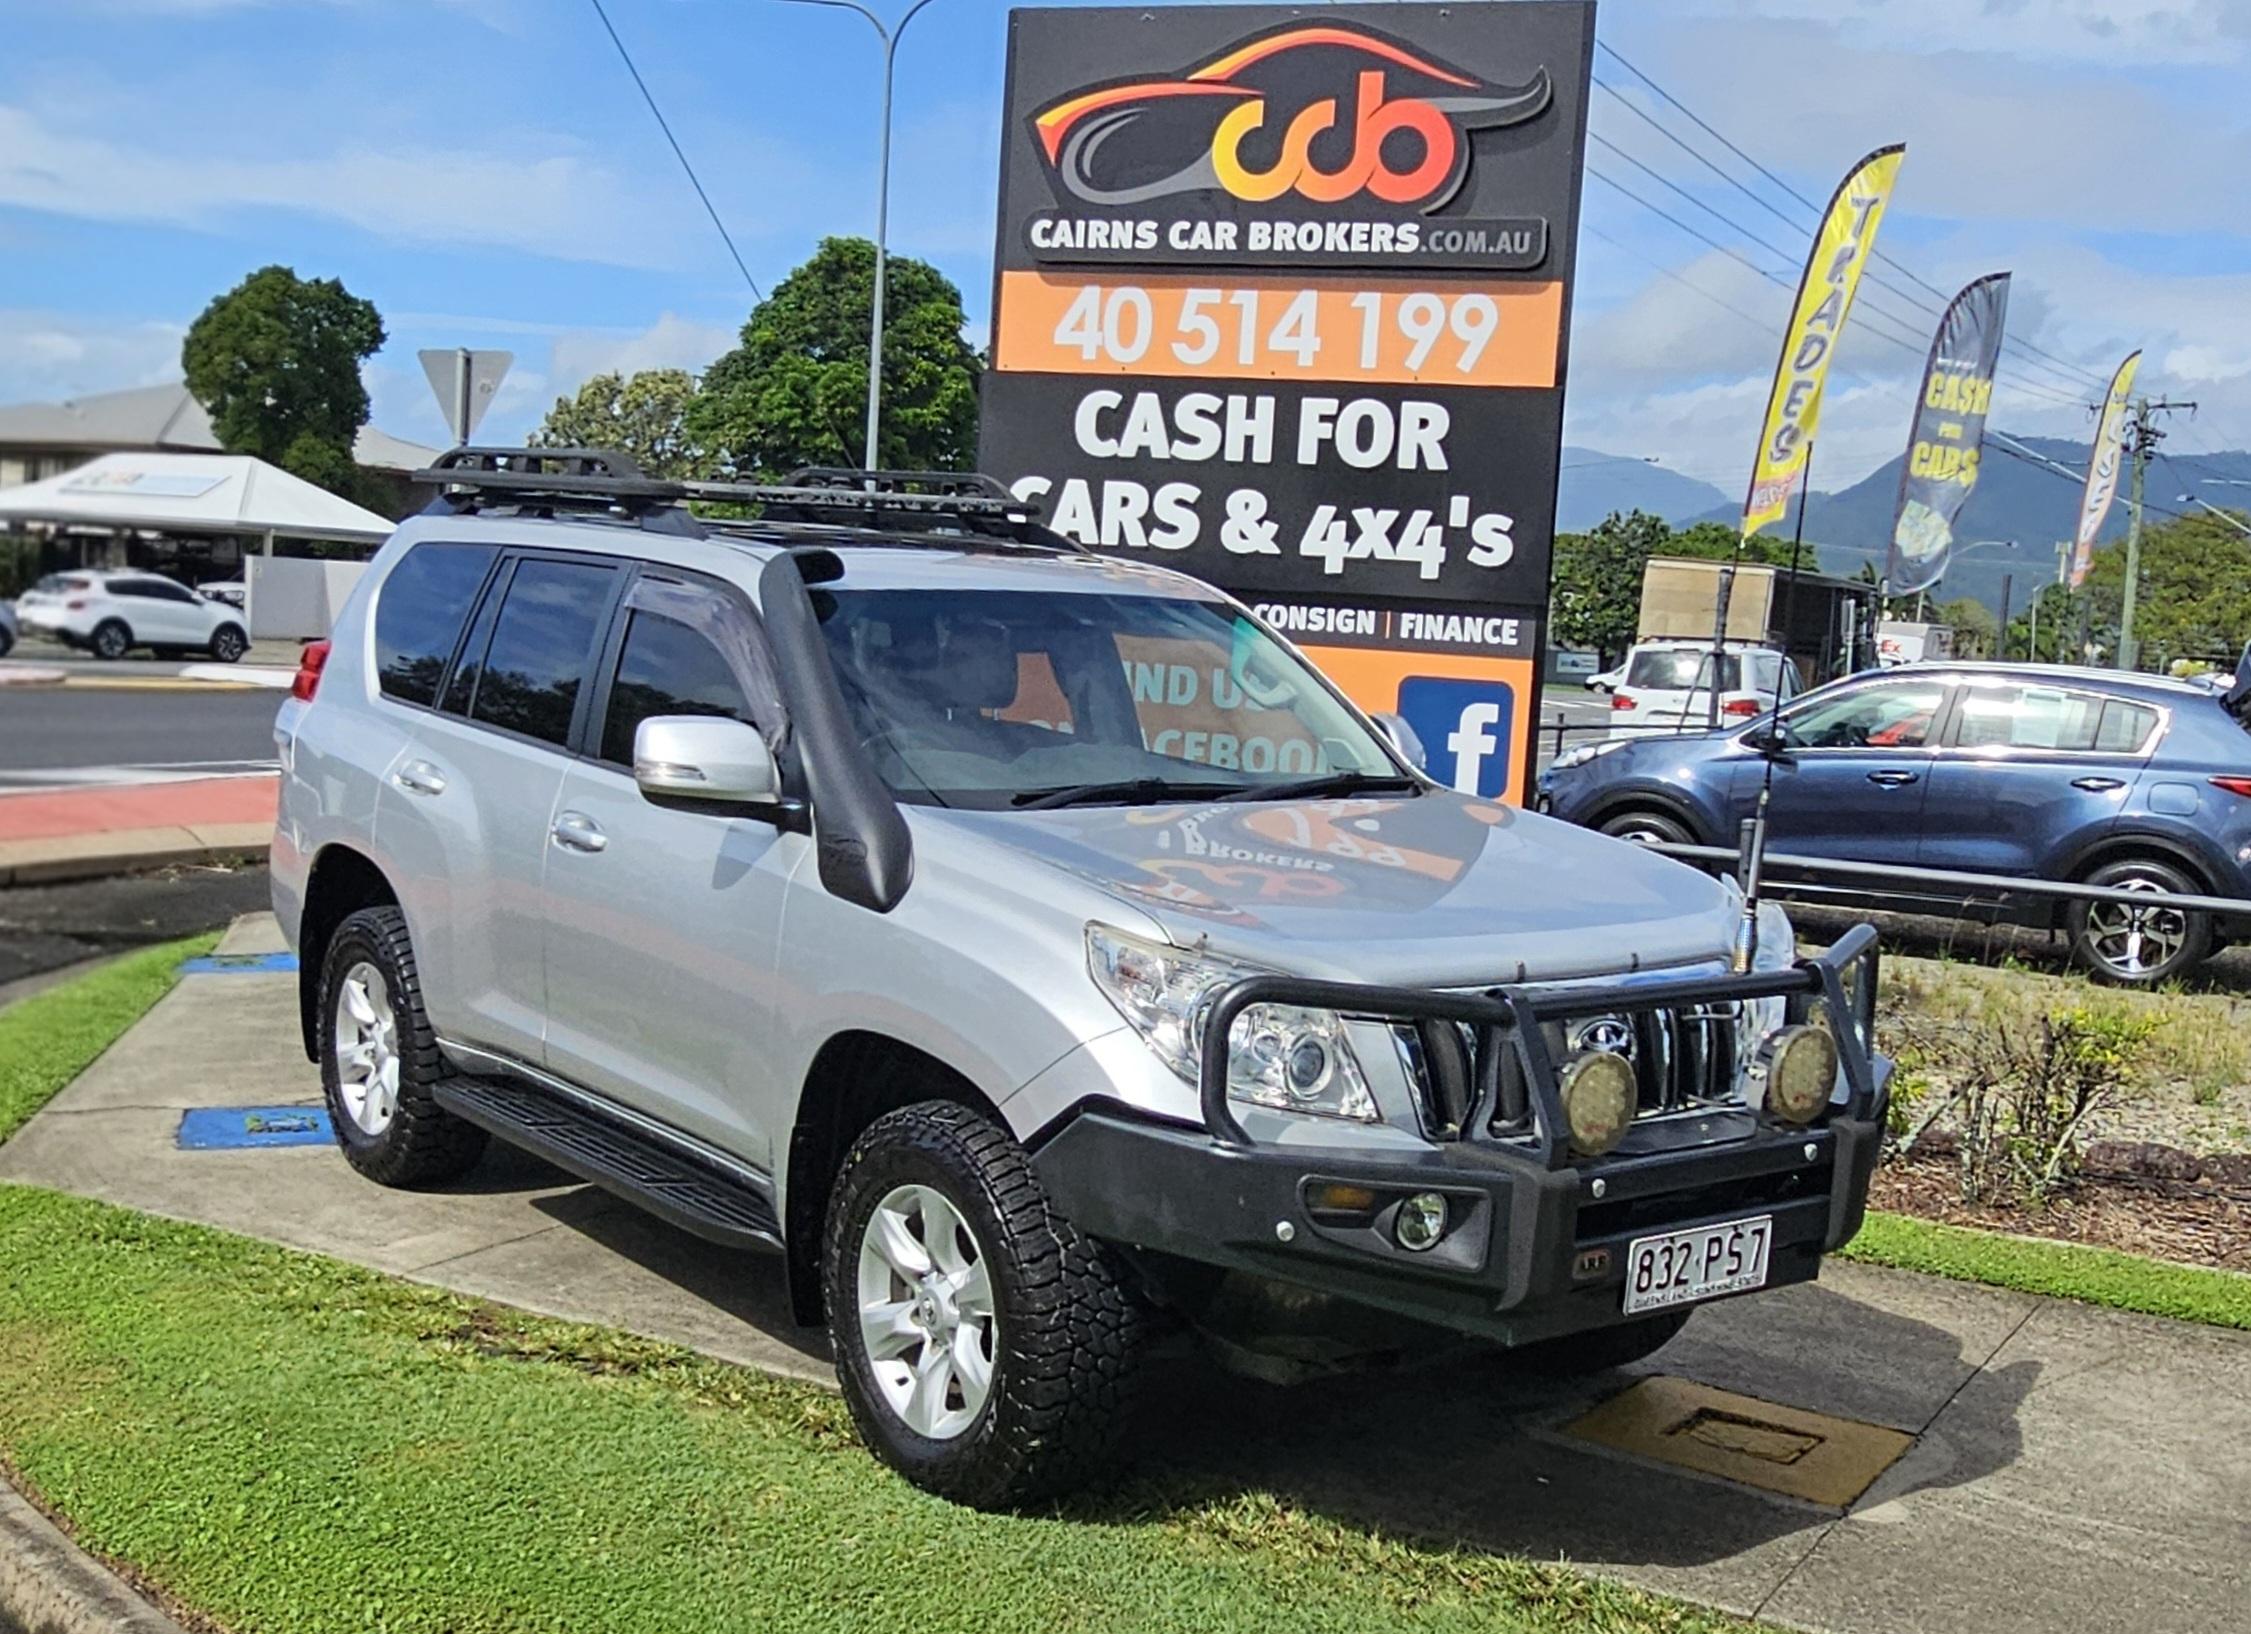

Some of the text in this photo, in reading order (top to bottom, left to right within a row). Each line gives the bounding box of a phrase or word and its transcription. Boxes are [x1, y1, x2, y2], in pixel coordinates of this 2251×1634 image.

[1031, 218, 1532, 255] CAIRNS CAR BROKERS.COM.AU
[1053, 285, 1499, 373] 40 514 199
[1768, 196, 1879, 464] TRADES
[1925, 372, 1992, 416] CASH
[1075, 389, 1450, 471] CASH FOR
[1910, 441, 1980, 488] CARS
[1220, 488, 1280, 554] &
[1253, 603, 1519, 646] CONSIGN FINANCE
[1122, 661, 1198, 706] IND
[1141, 729, 1333, 774] CEBOO
